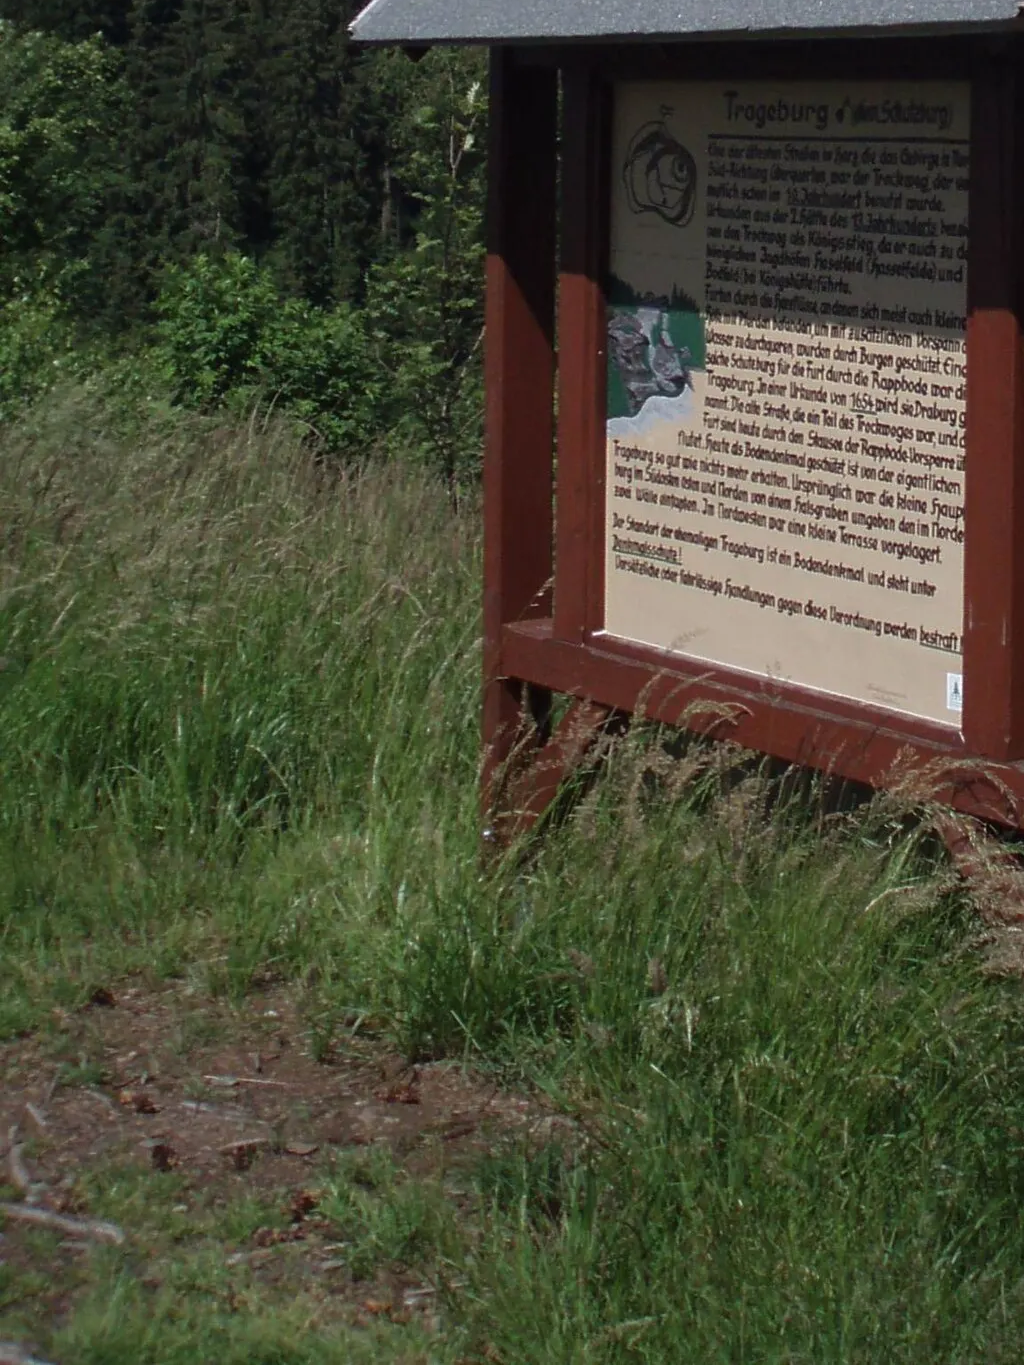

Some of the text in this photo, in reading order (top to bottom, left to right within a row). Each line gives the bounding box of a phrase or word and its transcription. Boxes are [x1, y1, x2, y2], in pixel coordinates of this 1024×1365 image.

[722, 90, 829, 129] Trageburg
[931, 497, 964, 525] Haup
[931, 520, 963, 543] Norde
